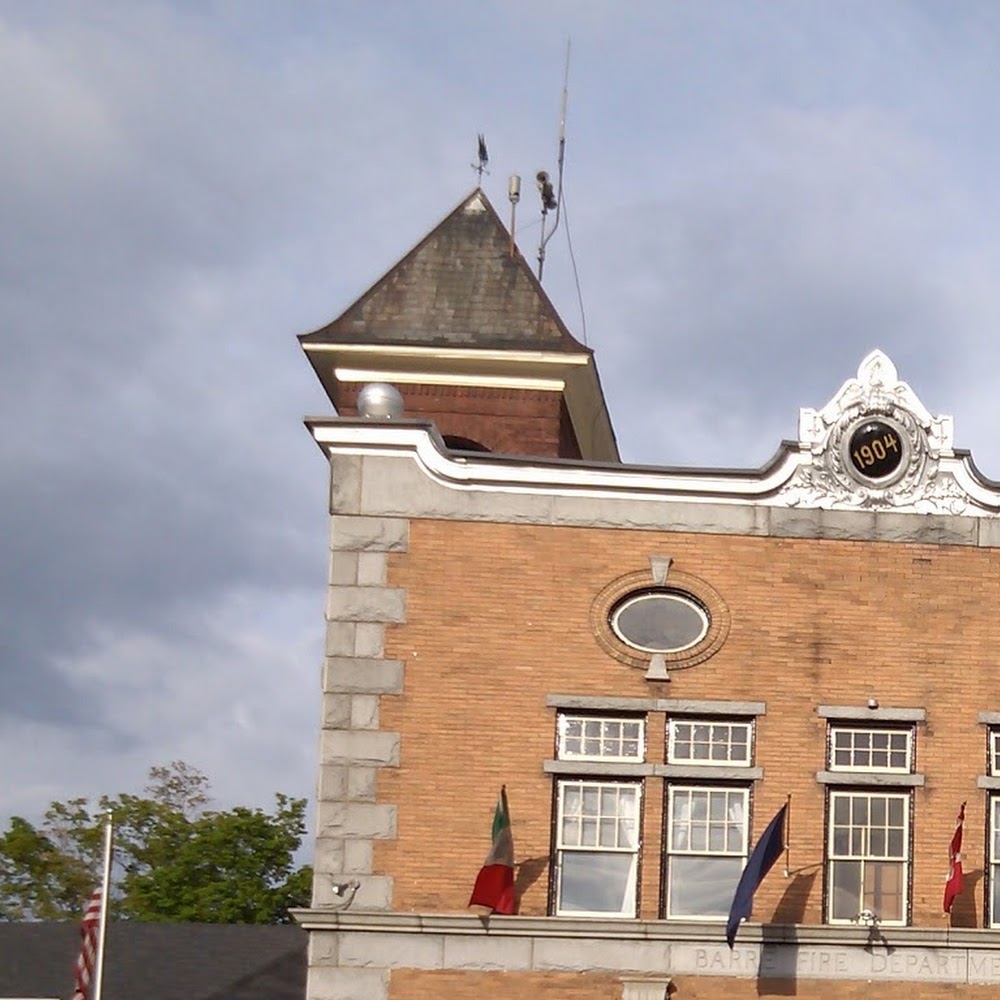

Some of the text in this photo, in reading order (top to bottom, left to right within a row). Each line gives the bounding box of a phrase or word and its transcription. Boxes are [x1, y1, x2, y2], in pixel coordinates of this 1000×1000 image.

[853, 433, 898, 469] 1904
[695, 948, 776, 971] BARRE
[799, 951, 849, 973] FIRE
